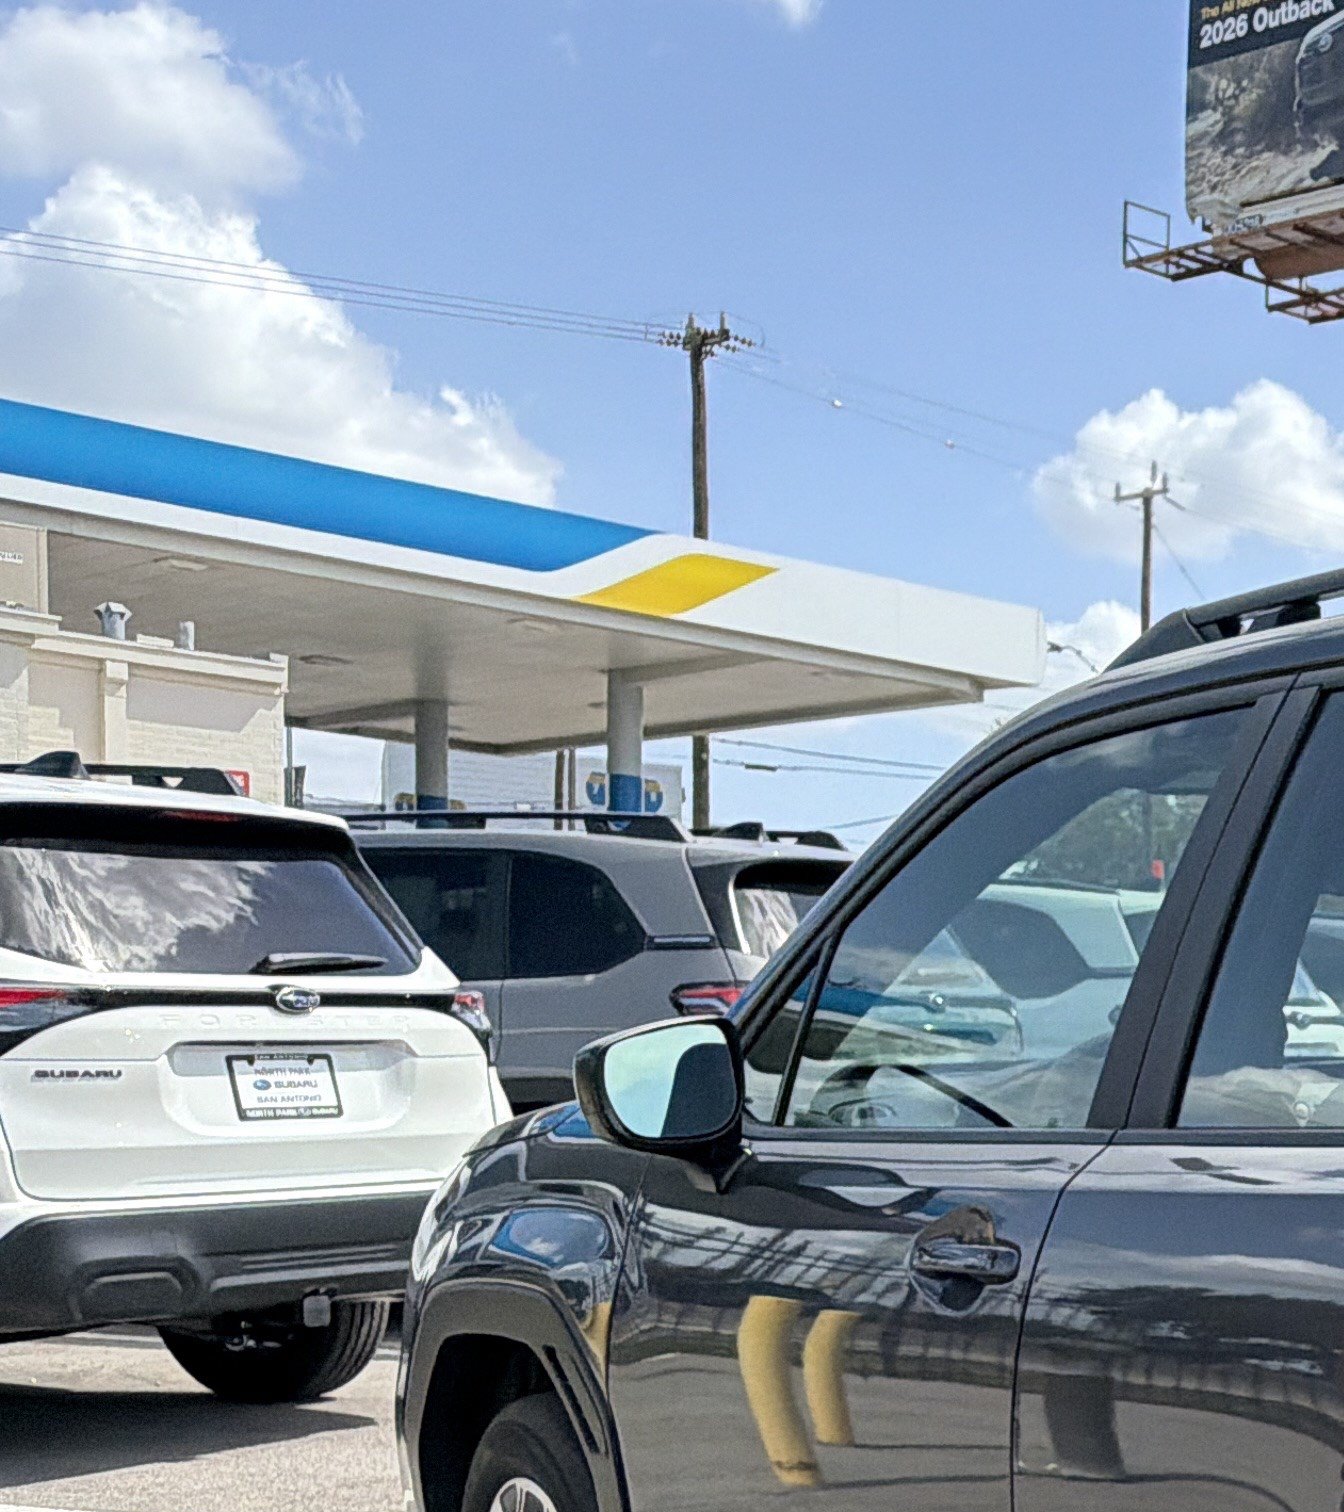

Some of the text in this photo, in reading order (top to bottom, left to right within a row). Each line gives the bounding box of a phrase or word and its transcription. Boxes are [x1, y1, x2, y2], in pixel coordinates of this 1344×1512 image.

[1200, 0, 1335, 49] 2026 Outback
[157, 1013, 408, 1028] FORSTER
[34, 1069, 122, 1080] SUBARU
[255, 1066, 311, 1076] NORTH PARK
[274, 1080, 318, 1089] SUBARU
[257, 1094, 321, 1103] SAN ANTONIO
